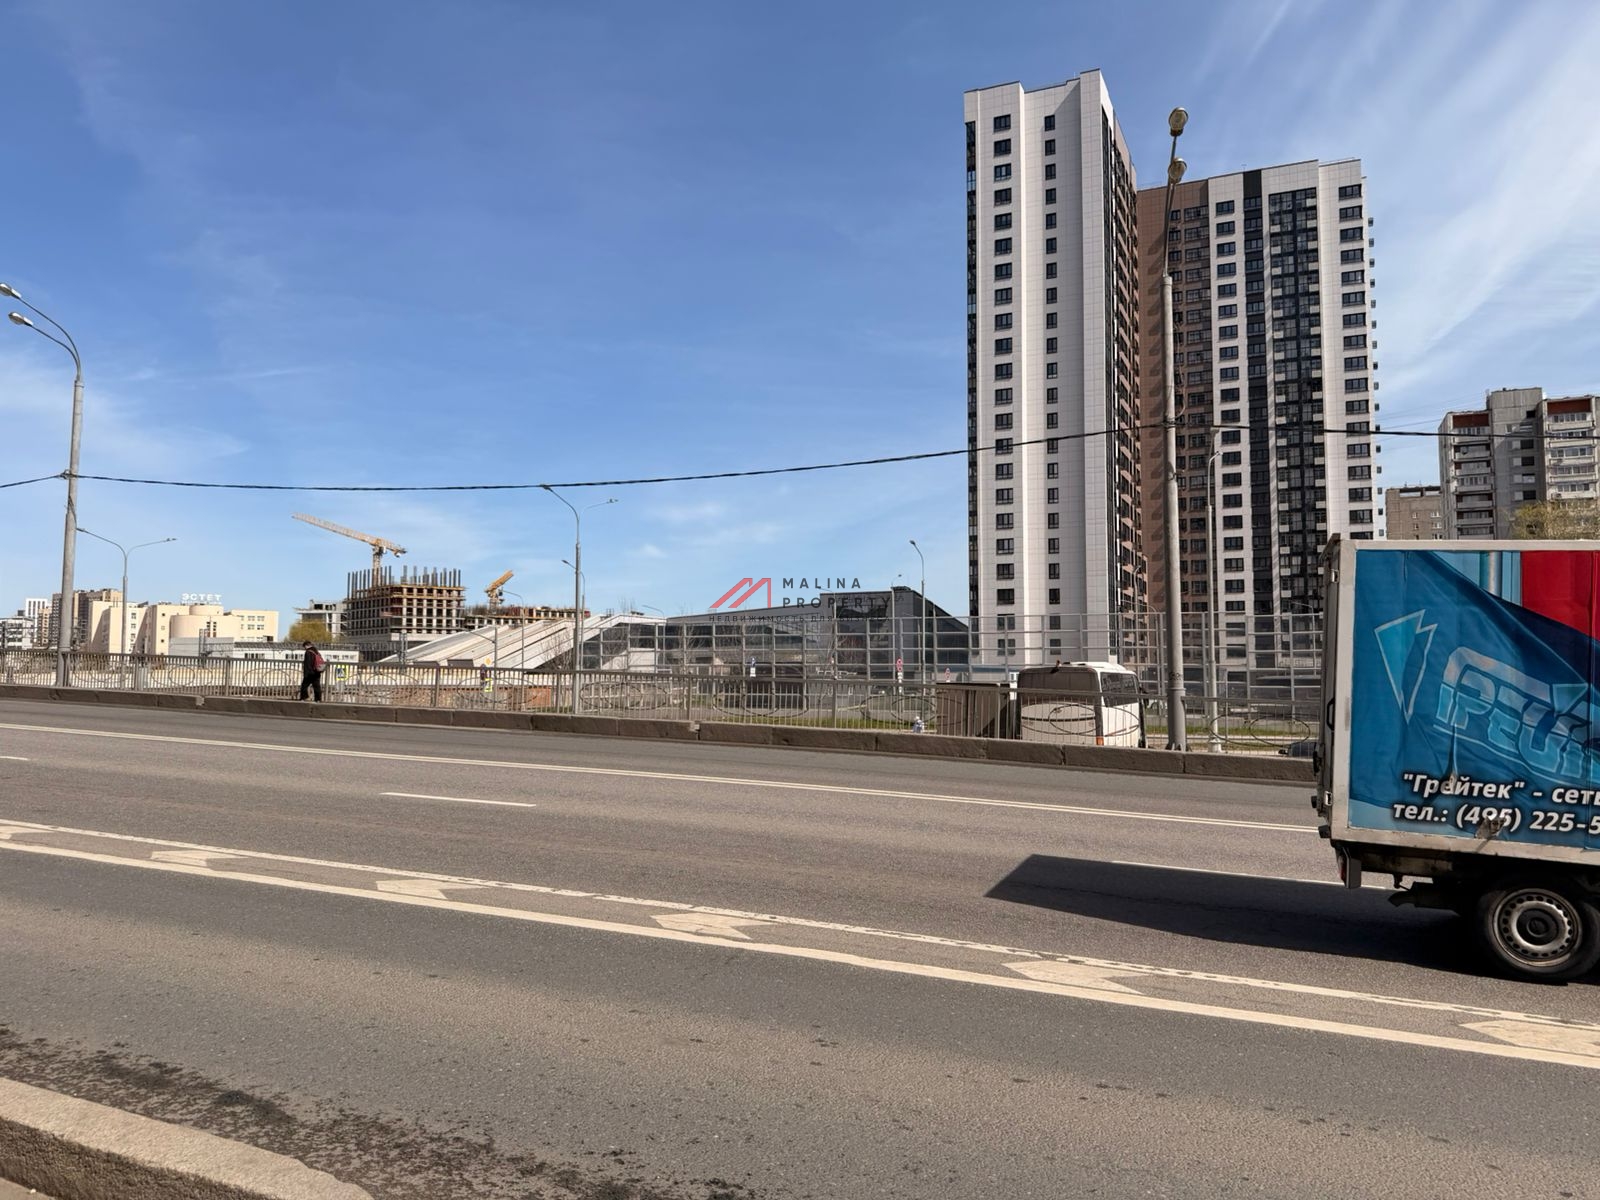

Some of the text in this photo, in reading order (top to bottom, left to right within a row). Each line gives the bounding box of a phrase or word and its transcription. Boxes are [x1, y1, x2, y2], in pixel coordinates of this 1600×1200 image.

[181, 593, 222, 601] ЭСТЕТ
[1403, 773, 1525, 799] "Грейтек"
[1393, 803, 1449, 823] тел.:
[1529, 811, 1600, 835] 225-5
